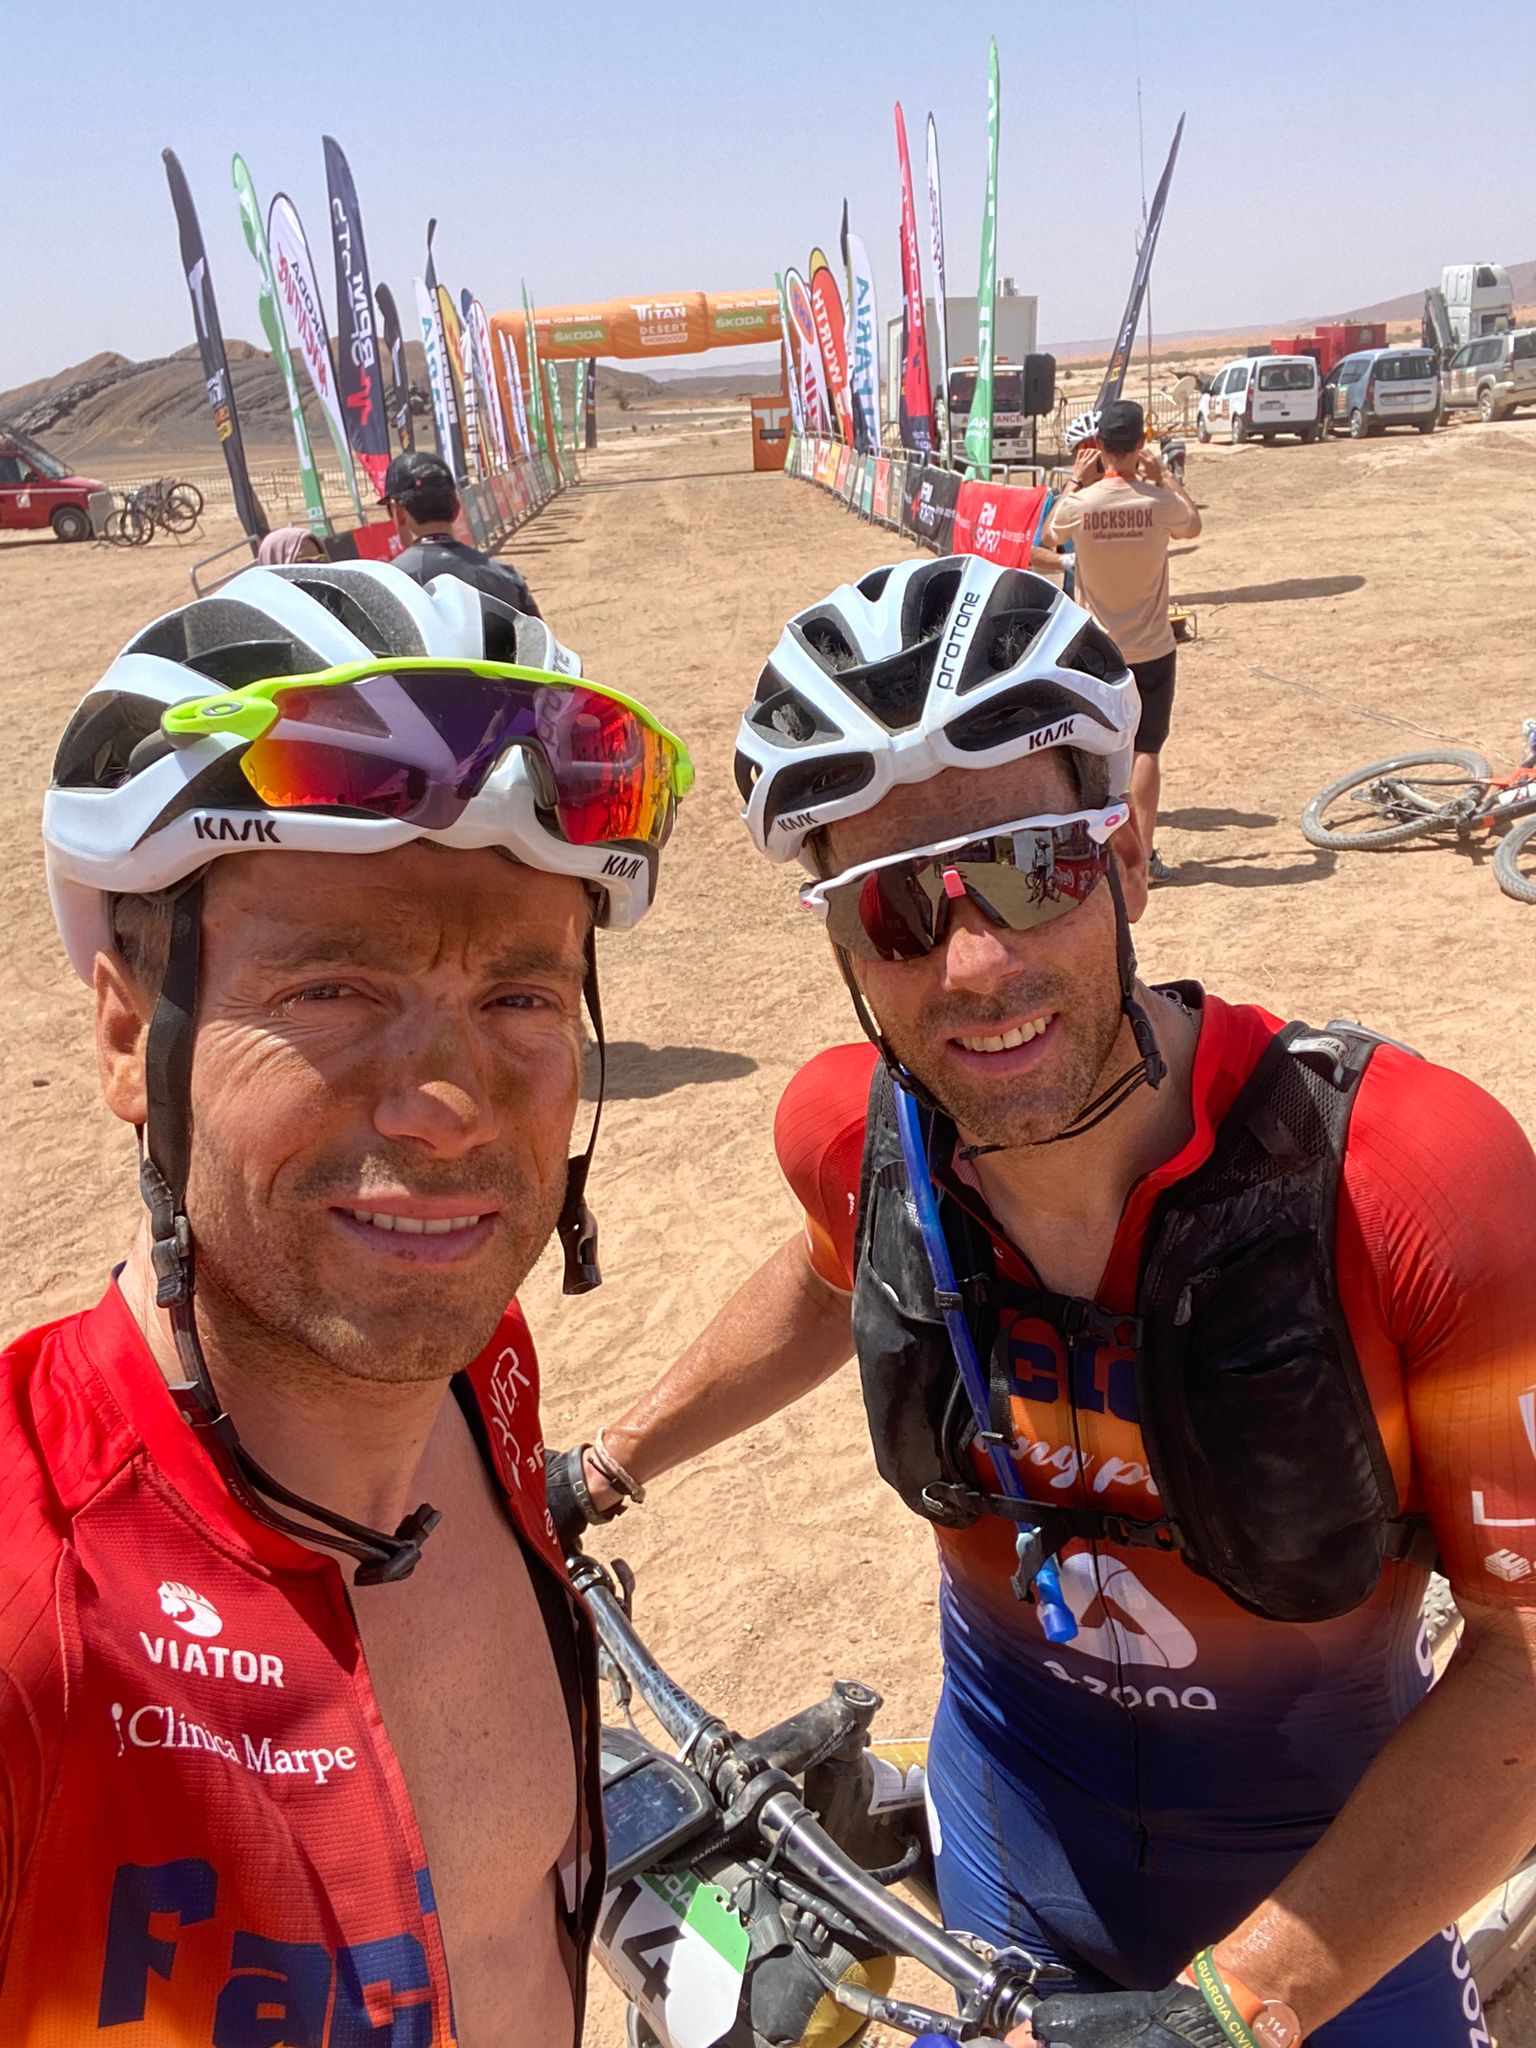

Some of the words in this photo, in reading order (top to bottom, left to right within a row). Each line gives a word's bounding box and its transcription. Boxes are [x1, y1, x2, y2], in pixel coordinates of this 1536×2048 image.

[630, 303, 687, 321] TITAN
[640, 323, 688, 336] DESERT
[1083, 508, 1153, 531] ROCKSHOX
[1028, 719, 1075, 750] KASK
[194, 815, 282, 844] KASK
[777, 812, 819, 832] KASK
[601, 854, 644, 881] KASK
[1317, 1040, 1347, 1059] CHAS
[139, 1631, 285, 1688] VIATOR
[241, 1733, 357, 1784] Marpe
[690, 1835, 731, 1864] GARMIN
[1197, 1960, 1232, 2021] GUARDIA
[1229, 2021, 1254, 2048] CIVI
[902, 2014, 931, 2030] XT
[1267, 2016, 1288, 2038] 114
